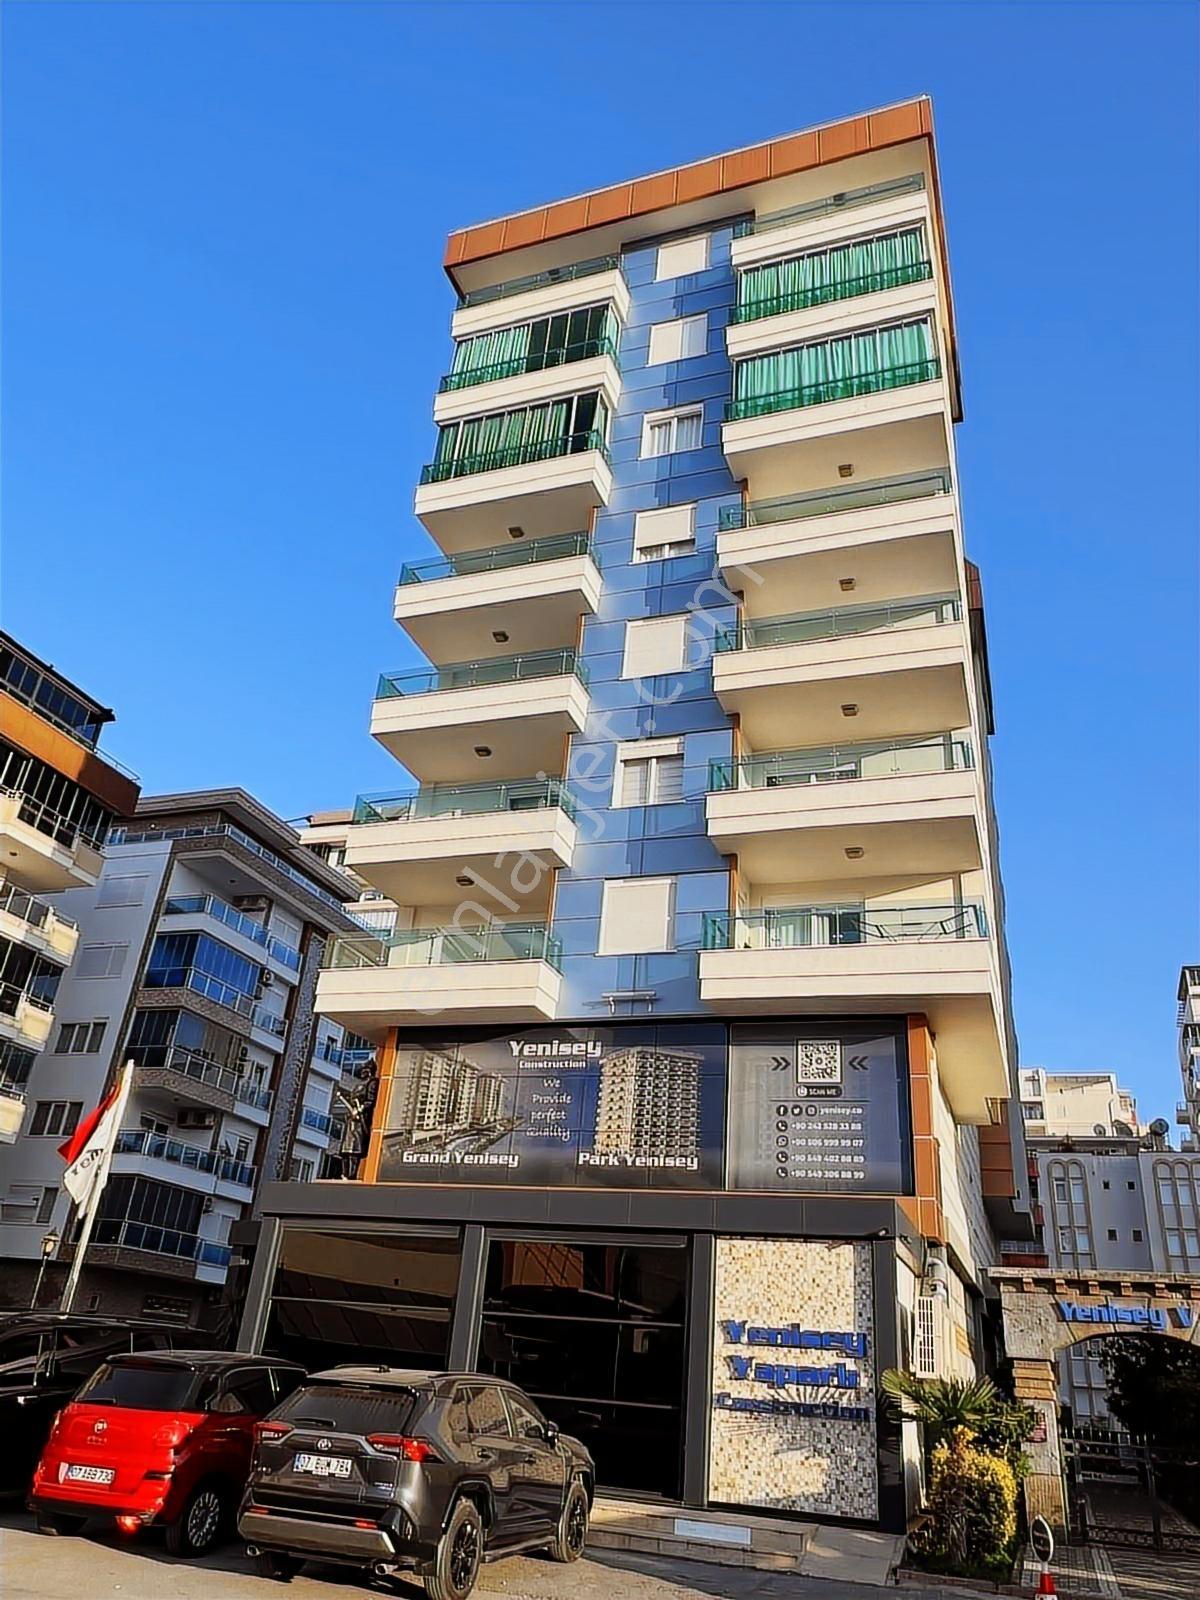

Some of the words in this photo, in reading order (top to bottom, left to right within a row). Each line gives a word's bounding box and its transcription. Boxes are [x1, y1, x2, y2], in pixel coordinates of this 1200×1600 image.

[509, 1040, 602, 1058] Yenisey
[519, 1060, 586, 1069] Construction
[402, 1151, 450, 1164] Grand
[455, 1152, 520, 1168] Yenisey
[578, 1152, 619, 1166] Park
[623, 1154, 699, 1171] Yenisey
[1058, 1301, 1167, 1331] Yenisey
[719, 1319, 867, 1359] Yenisey
